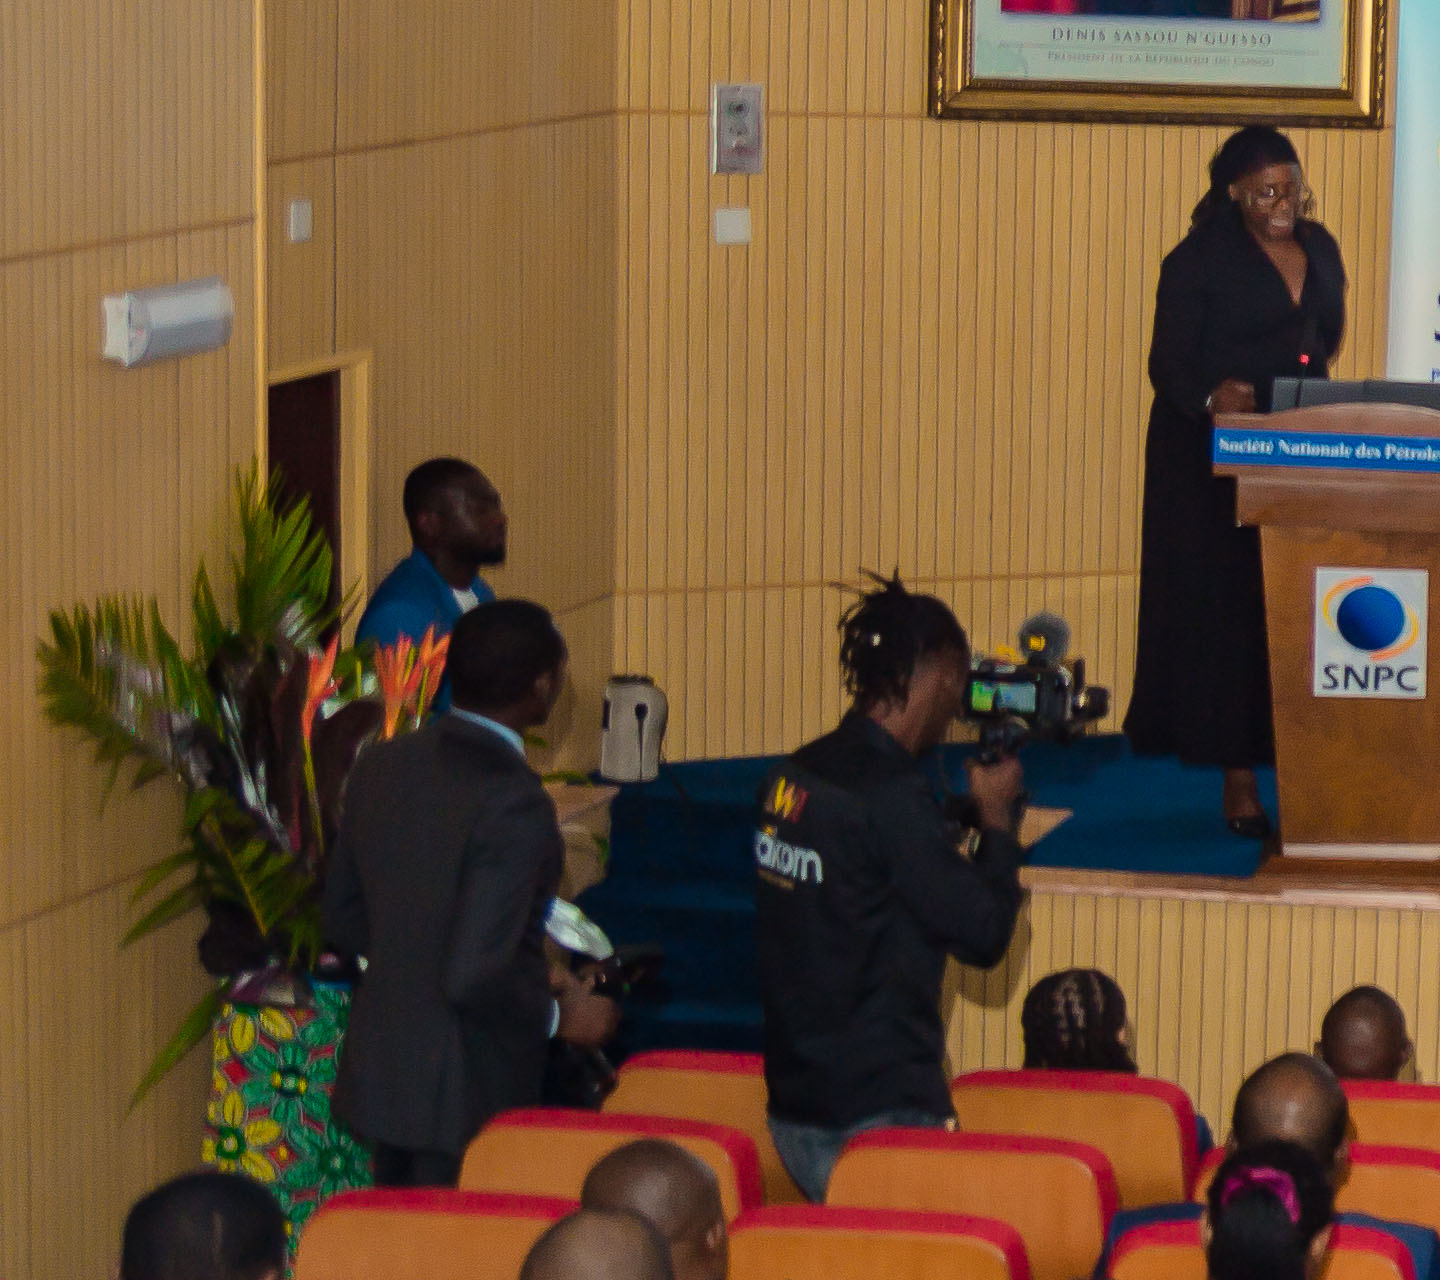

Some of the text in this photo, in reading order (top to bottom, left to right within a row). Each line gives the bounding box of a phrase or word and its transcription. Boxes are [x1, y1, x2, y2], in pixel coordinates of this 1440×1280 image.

[1052, 28, 1106, 41] DENIS
[1114, 29, 1178, 43] SASSOU
[1218, 437, 1273, 456] Société
[1278, 439, 1353, 460] Nationale
[1354, 441, 1382, 460] des
[1321, 663, 1419, 693] SNPC
